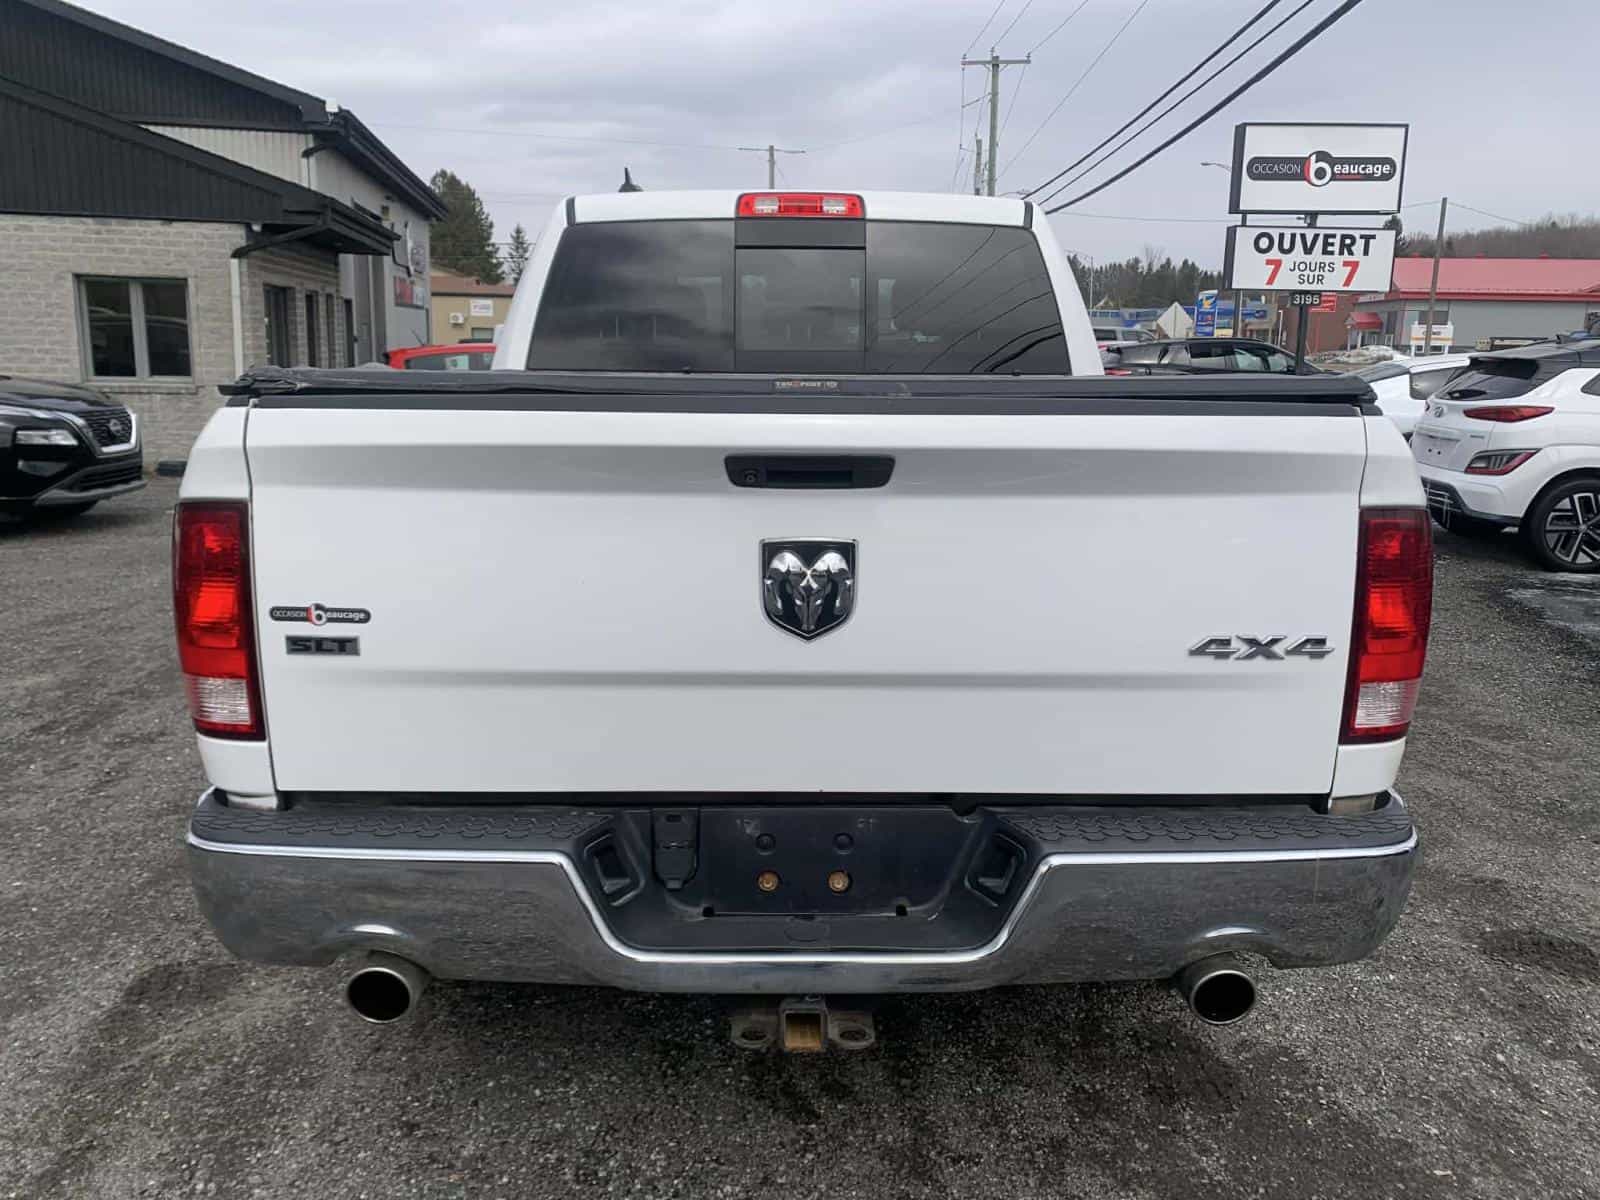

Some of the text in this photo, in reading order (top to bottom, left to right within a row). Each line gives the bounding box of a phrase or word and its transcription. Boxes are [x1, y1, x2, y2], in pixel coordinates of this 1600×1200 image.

[1252, 163, 1301, 175] OCCASION
[1253, 231, 1377, 257] OUVERT
[1264, 258, 1283, 286] 7
[1288, 261, 1336, 274] JOURS
[1341, 260, 1361, 288] 7
[1297, 273, 1325, 285] SUR
[288, 637, 355, 654] SLT
